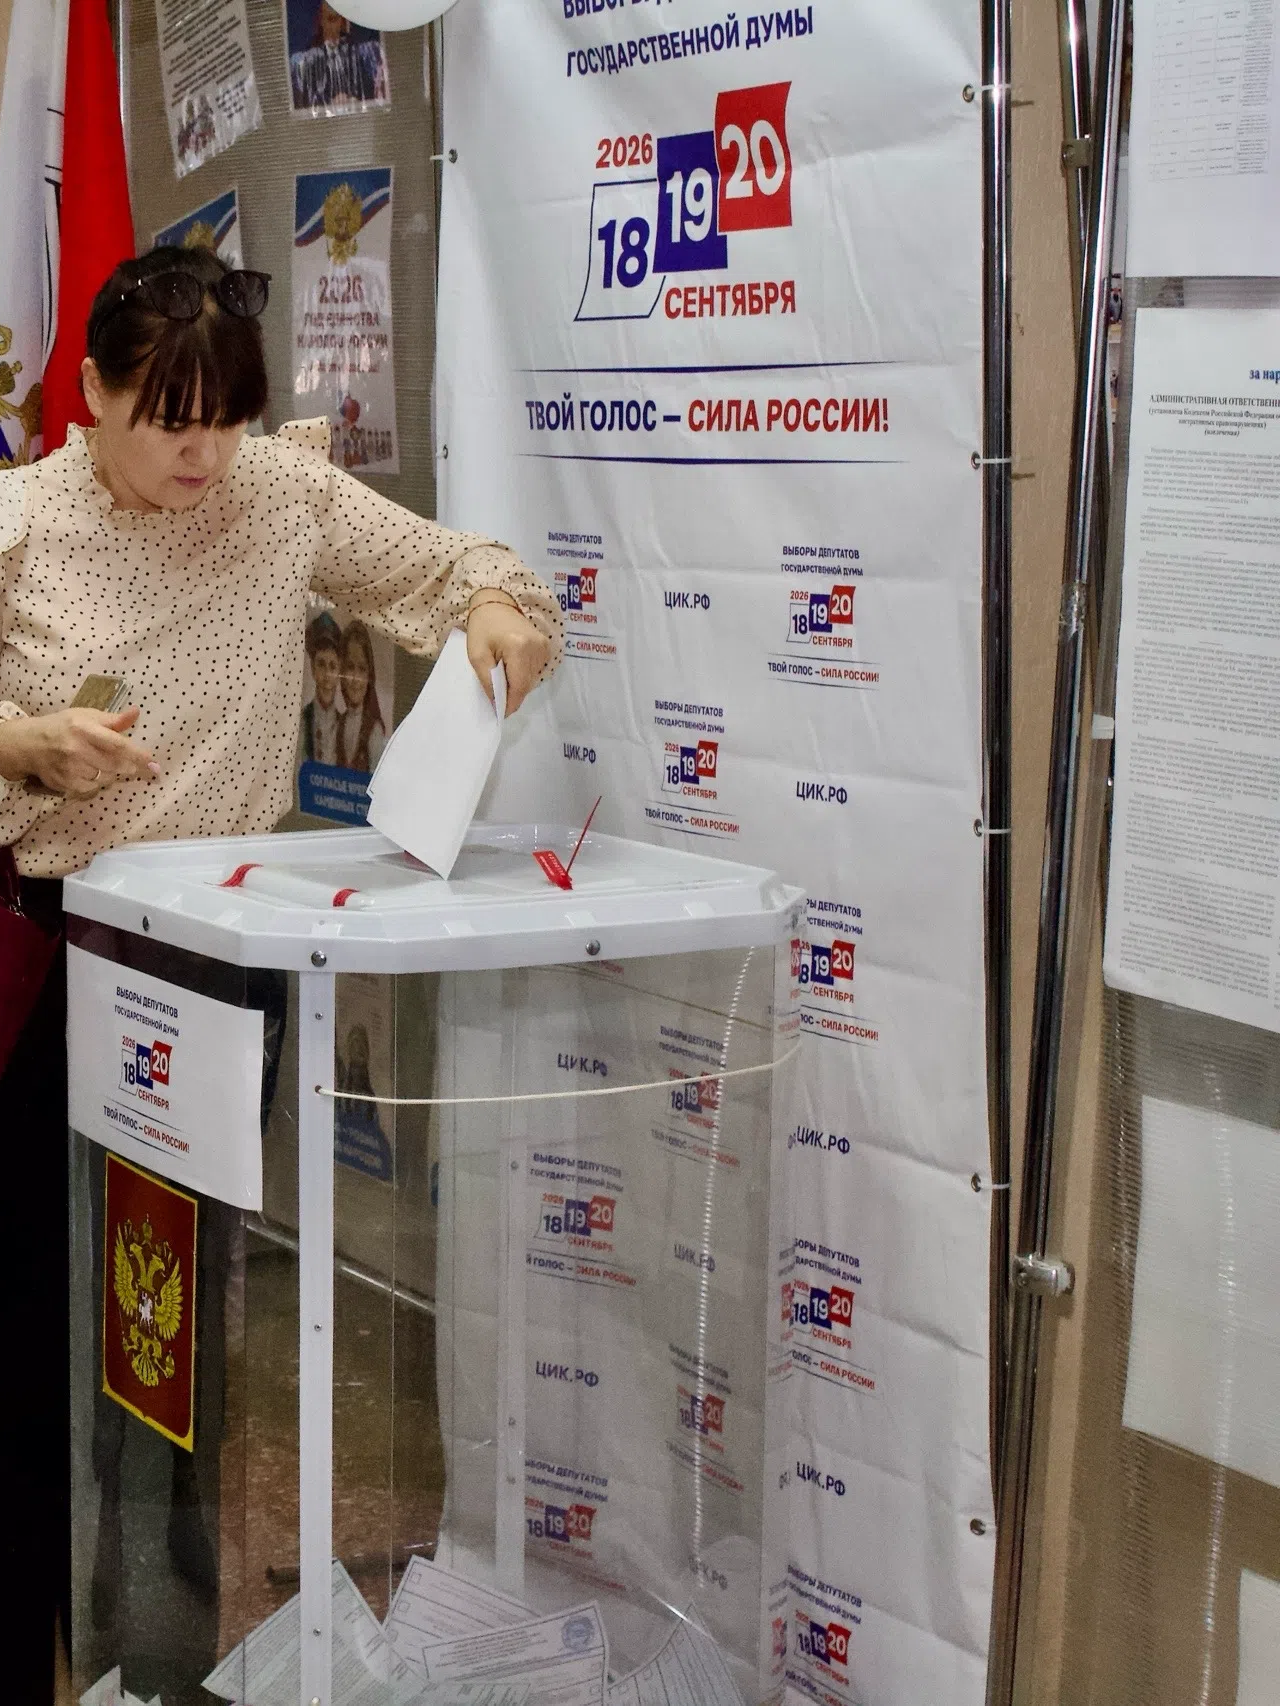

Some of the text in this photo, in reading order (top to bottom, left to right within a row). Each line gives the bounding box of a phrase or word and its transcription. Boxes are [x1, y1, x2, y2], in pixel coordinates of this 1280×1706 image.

[566, 6, 813, 77] ГОСУДАРСТВЕННОЙ ДУМЫ
[595, 133, 653, 169] 2026
[598, 119, 786, 289] 18 19 20
[664, 280, 796, 319] СЕНТЯБРЯ
[1249, 369, 1260, 380] за
[525, 392, 575, 431] ТВОЙ
[580, 399, 657, 432] ГОЛОС
[688, 398, 760, 432] СИЛА
[766, 398, 890, 432] РОССИИ!
[782, 545, 860, 559] ВЫБОРЫ ДЕПУТАТОВ
[781, 563, 864, 577] ГОСУДАРСТВЕННОЙ ДУМЫ
[569, 583, 580, 603] 19
[581, 575, 594, 596] 20
[664, 591, 711, 612] ЦИК.РФ
[790, 590, 809, 601] 2026
[792, 594, 852, 635] 18 19 20
[812, 635, 853, 648] СЕНТЯБРЯ
[767, 661, 787, 673] ТВОЙ
[788, 664, 813, 676] ГОЛОС
[821, 667, 843, 679] СИЛА
[844, 669, 880, 683] РОССИИ!
[654, 699, 724, 718] ВЫБОРЫ ДЕПУТАТОВ
[707, 724, 725, 734] ДУМЫ
[563, 742, 597, 765] ЦИК.РФ
[666, 748, 716, 785] 18 19 20
[682, 786, 718, 800] СЕНТЯБРЯ
[795, 780, 848, 805] ЦИК.РФ
[645, 807, 661, 819] ТВОЙ
[661, 811, 684, 824] ГОЛОС
[690, 816, 709, 828] СИЛА
[709, 820, 740, 834] РОССИИ!
[818, 900, 862, 919] ДЕПУТАТОВ
[844, 924, 863, 935] ДУМЫ
[799, 948, 853, 984] 8 19 20
[116, 986, 179, 1019] ВЫБОРЫ ДЕПУТАТОВ
[813, 985, 854, 1003] СЕНТЯБРЯ
[114, 1004, 180, 1038] ГОСУДАРСТВЕННОЙ ДУМЫ
[821, 1018, 842, 1032] СИЛА
[844, 1025, 879, 1041] РОССИИ!
[122, 1035, 135, 1050] 2026
[123, 1049, 168, 1085] 18 19 20
[138, 1089, 170, 1110] СЕНТЯБРЯ
[671, 1090, 684, 1111] 18
[103, 1105, 118, 1119] ТВОЙ
[118, 1113, 138, 1130] ГОЛОС
[144, 1124, 161, 1140] СИЛА
[161, 1131, 190, 1153] РОССИИ!
[797, 1126, 850, 1154] ЦИК.РФ
[530, 1168, 605, 1187] ГОСУДАРСТЕННОЙ
[543, 1203, 612, 1234] 18 19 20
[793, 1238, 816, 1253] БОРЫ
[841, 1271, 862, 1285] ДУМЫ
[793, 1293, 851, 1325] 18 19 20
[535, 1360, 599, 1387] ЦИК.РФ
[792, 1350, 812, 1365] ОЛОС
[820, 1360, 840, 1377] СИЛА
[525, 1459, 556, 1475] ЫБОРЫ
[796, 1461, 846, 1496] ЦИК.РФ
[527, 1518, 543, 1538] 18
[548, 1513, 565, 1534] 19
[828, 1630, 846, 1656] 20
